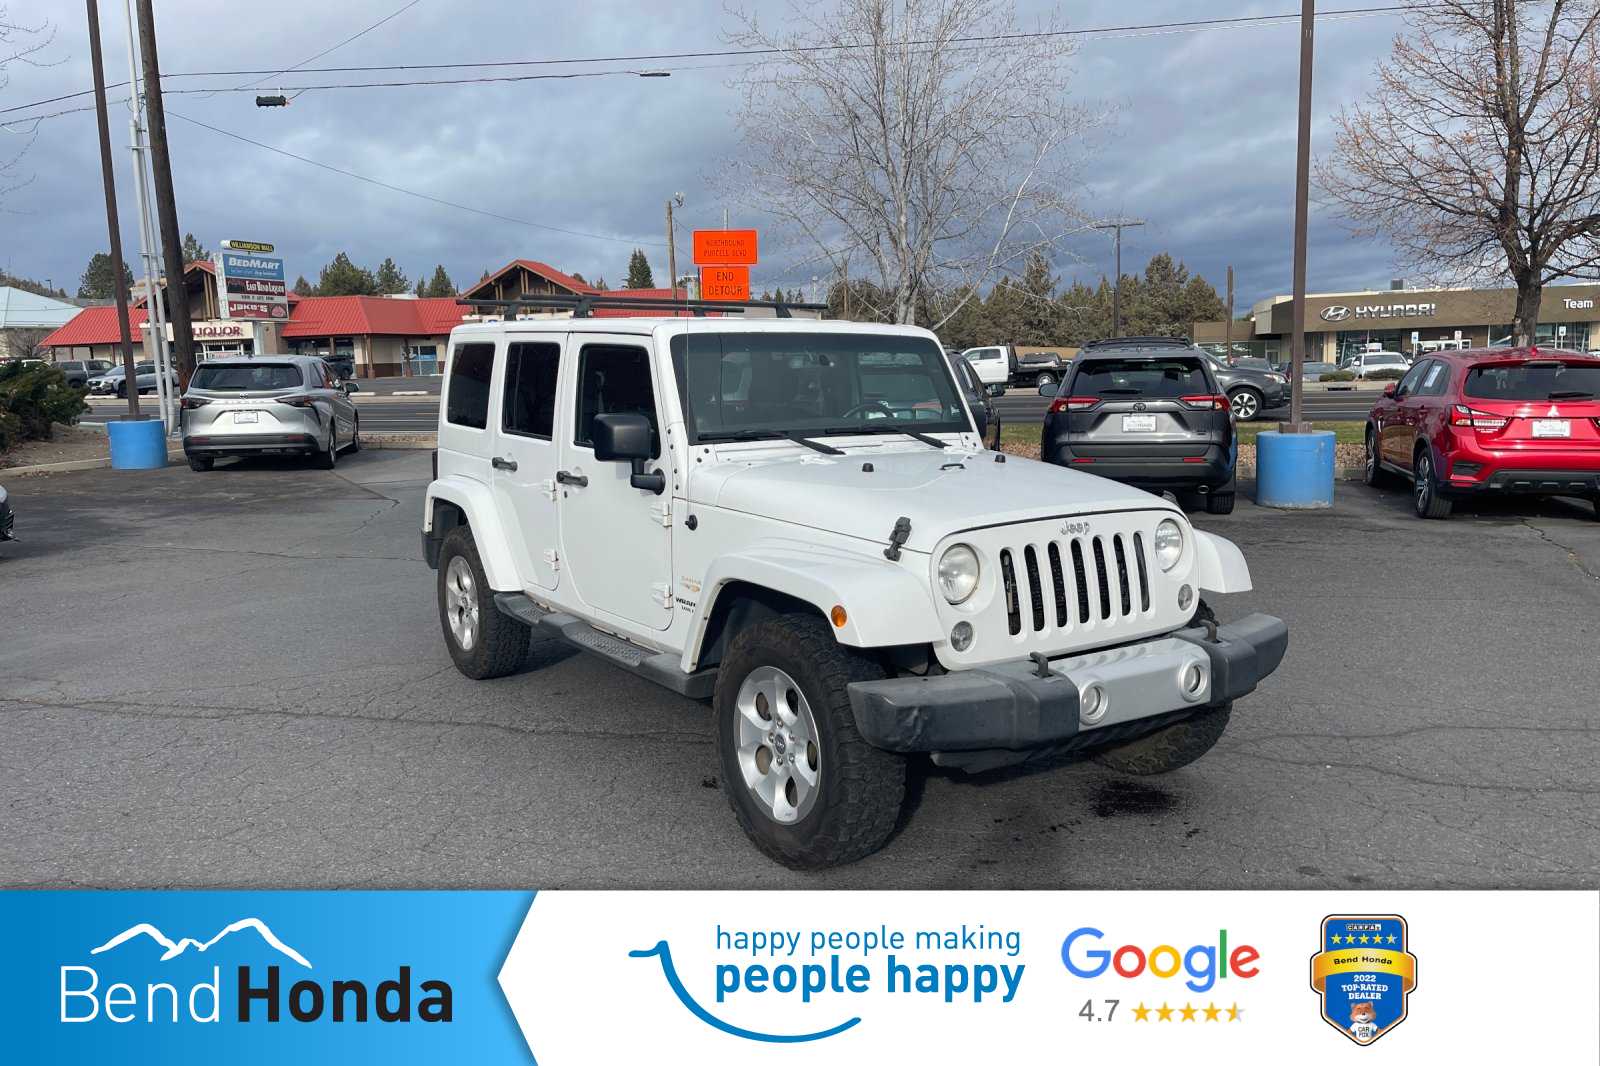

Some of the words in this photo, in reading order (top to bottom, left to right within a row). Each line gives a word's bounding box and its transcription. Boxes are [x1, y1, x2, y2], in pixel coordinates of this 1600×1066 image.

[228, 257, 280, 270] BEDMART
[716, 271, 734, 281] END
[708, 285, 743, 296] DETOUR
[1563, 298, 1594, 310] Team
[1355, 303, 1436, 319] HYUNDAI
[192, 326, 241, 337] LIQUOR
[1060, 520, 1090, 536] Jeep
